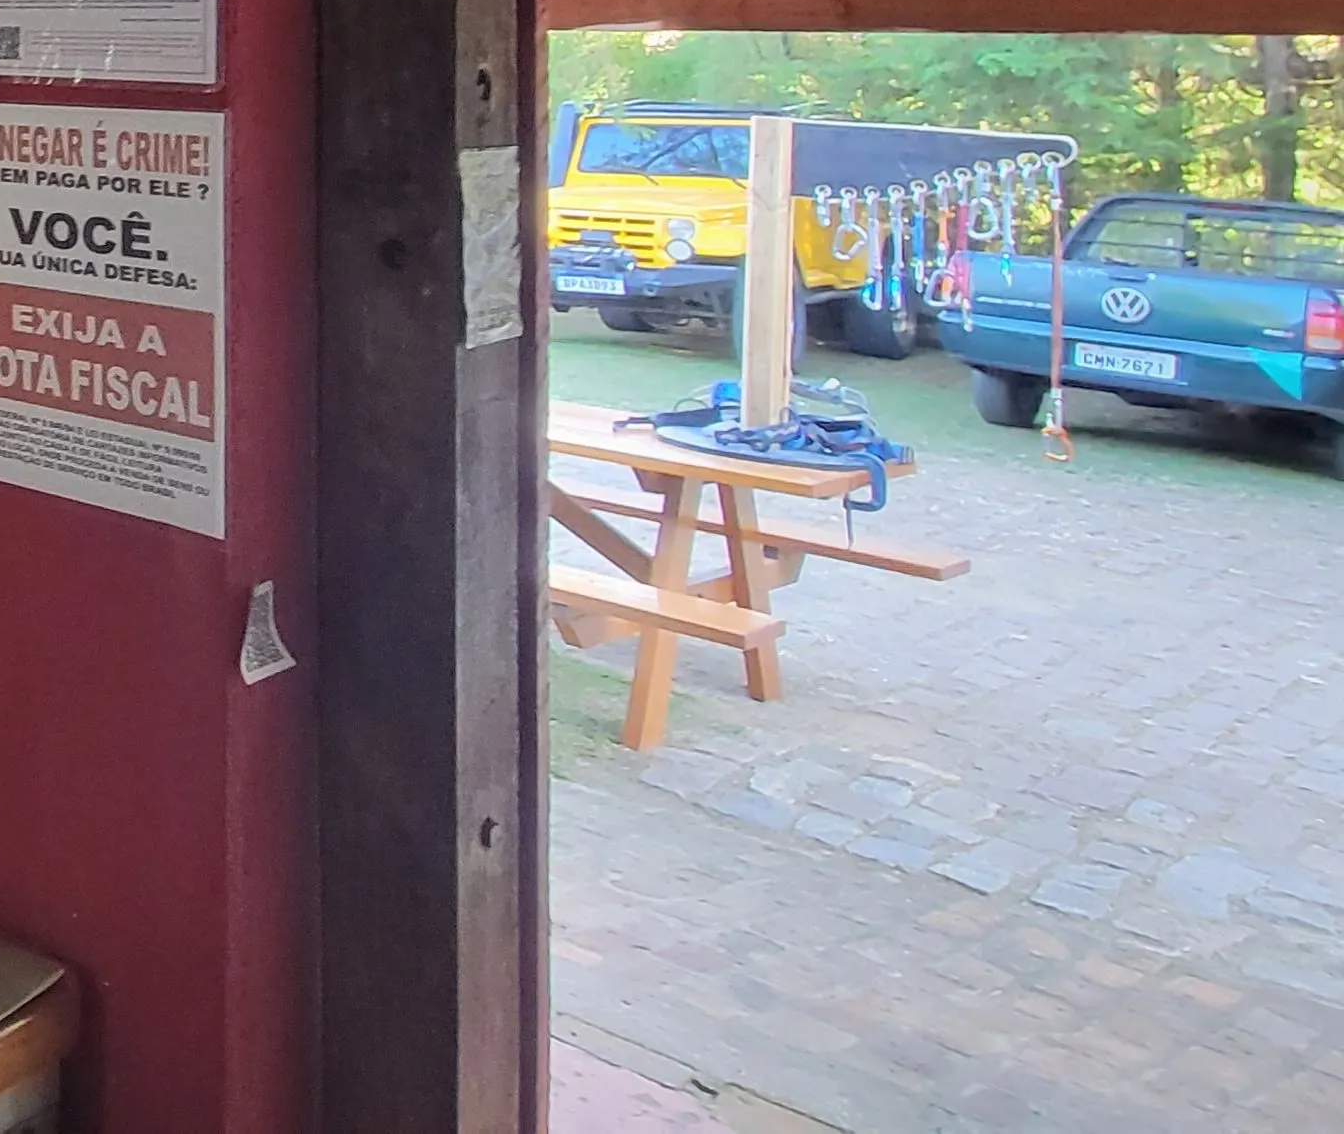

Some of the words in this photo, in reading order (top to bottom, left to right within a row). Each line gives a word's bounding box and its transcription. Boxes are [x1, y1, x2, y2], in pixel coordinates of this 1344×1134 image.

[91, 120, 108, 168] É
[115, 130, 211, 178] CRIME!
[35, 170, 91, 192] PAGA
[97, 176, 142, 196] POR
[149, 180, 192, 199] ELE
[196, 182, 210, 201] ?
[8, 206, 169, 262] VOCÊ.
[31, 250, 98, 278] ÚNICA
[103, 263, 198, 292] DEFESA:
[11, 303, 126, 350] EXIJA
[137, 324, 167, 357] A
[69, 358, 212, 429] FISCAL
